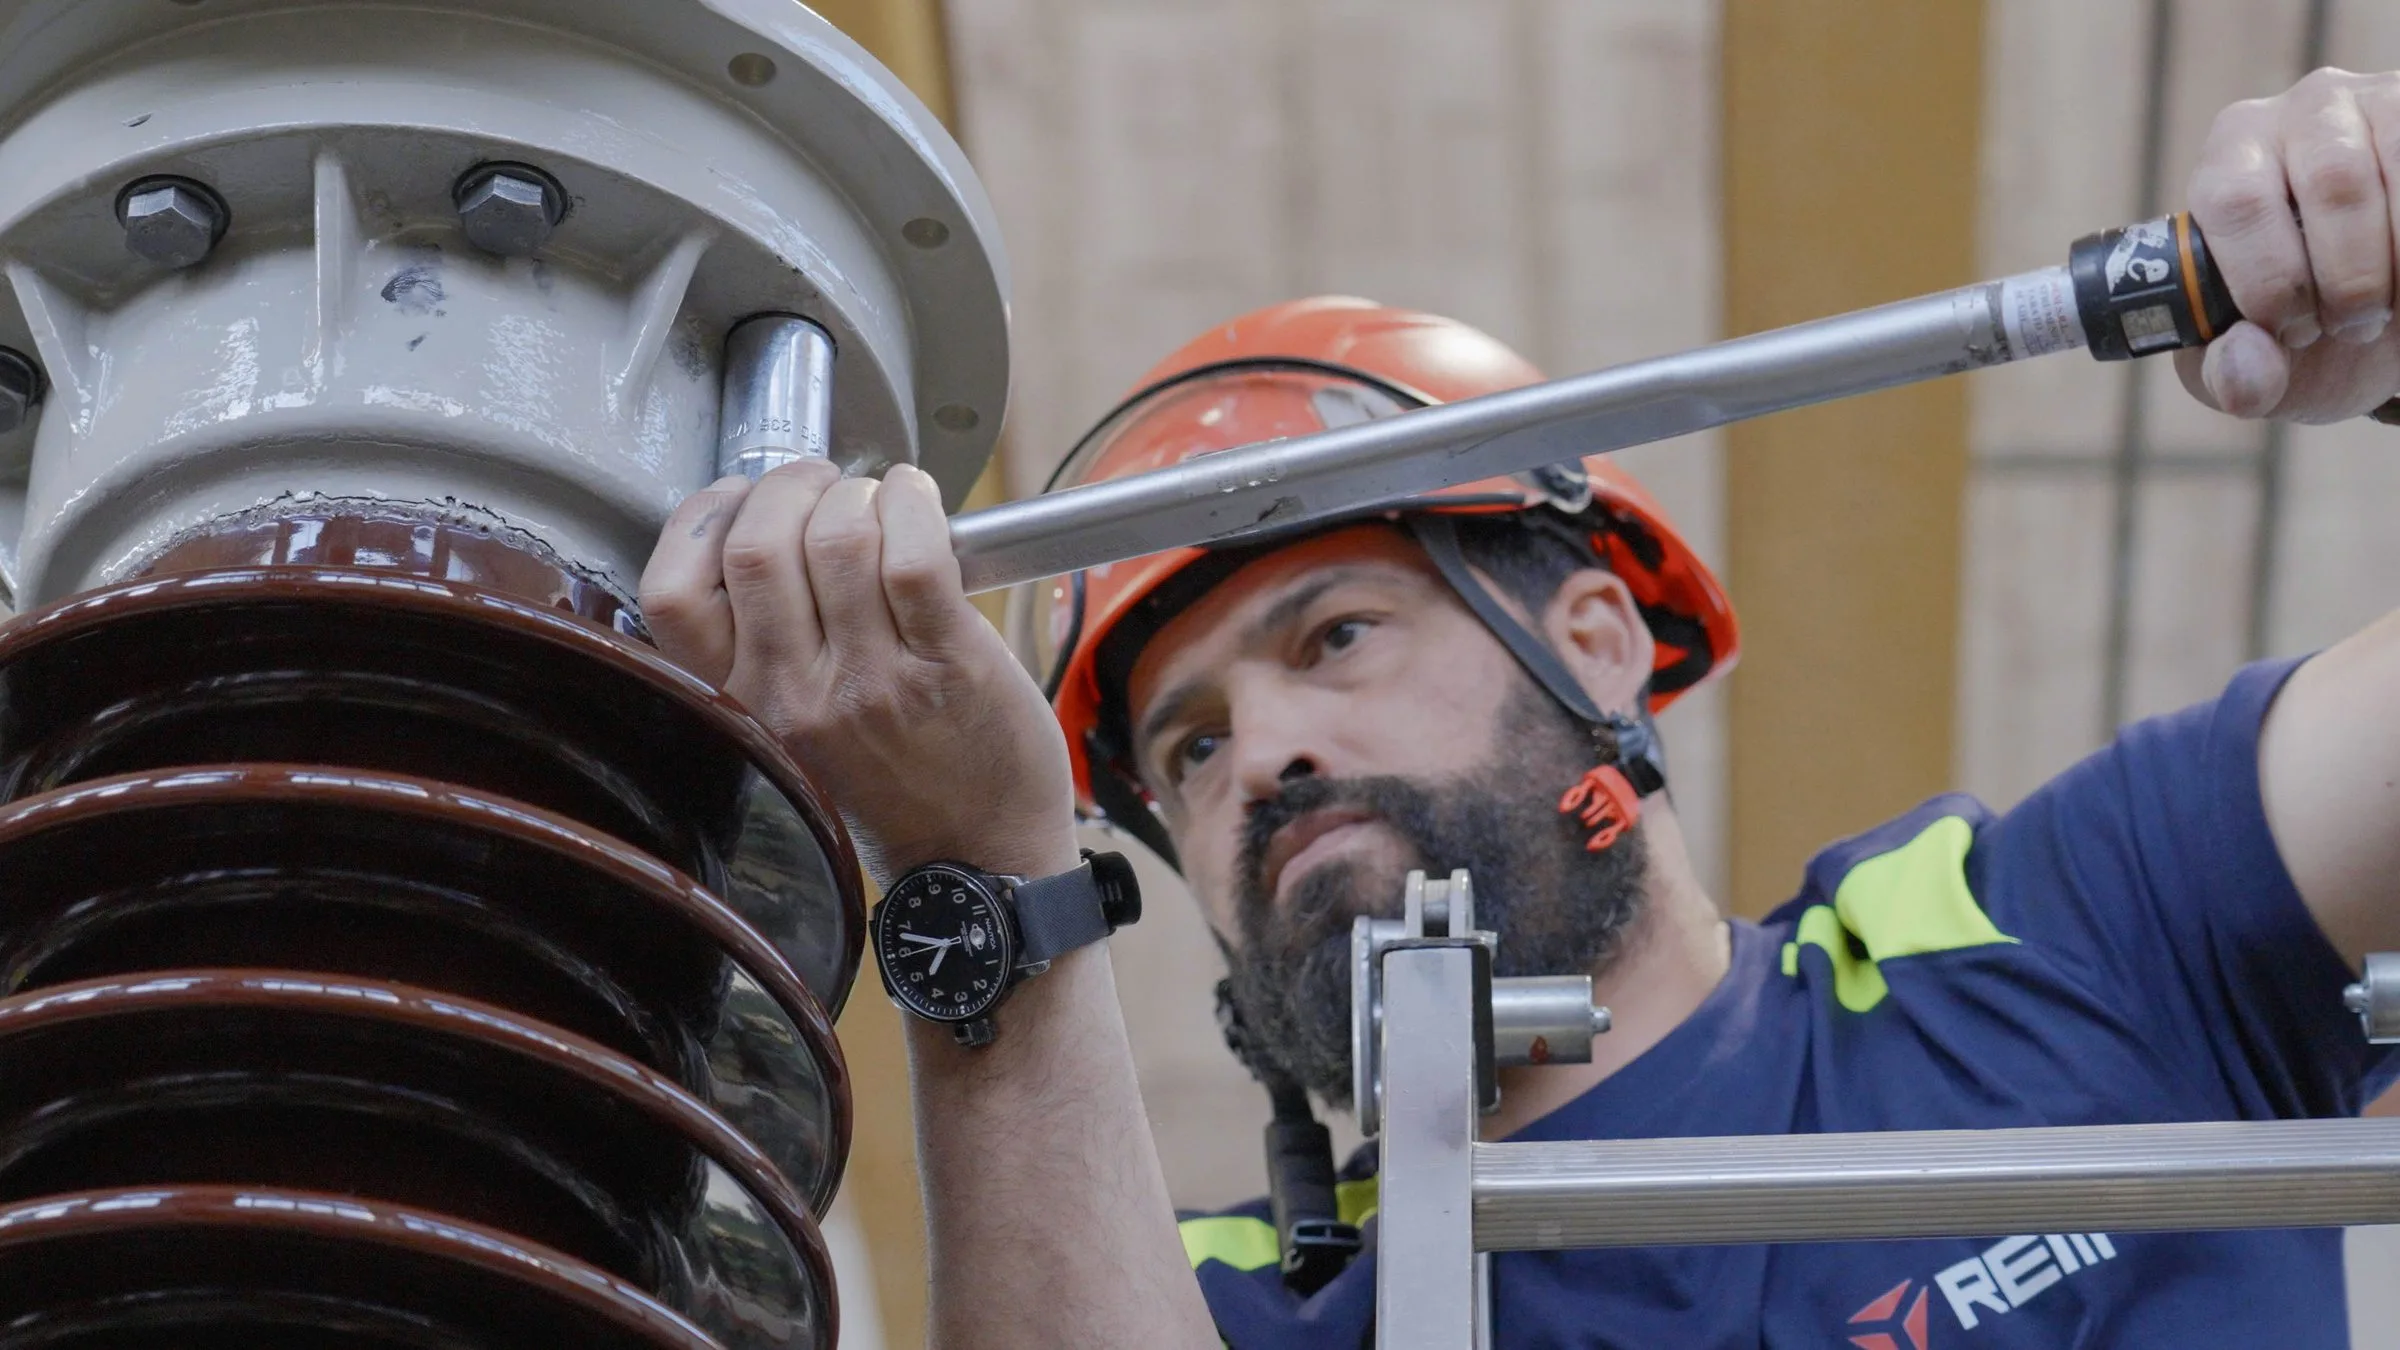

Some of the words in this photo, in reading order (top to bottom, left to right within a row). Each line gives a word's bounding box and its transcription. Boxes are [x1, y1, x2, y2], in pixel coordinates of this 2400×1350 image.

[928, 884, 941, 895] 9
[951, 887, 966, 904] 10
[908, 897, 921, 908] 8
[972, 904, 987, 915] 11
[899, 920, 912, 931] 7
[985, 917, 997, 950] NAUTICA
[910, 971, 924, 983] 5
[973, 979, 987, 991] 2
[931, 987, 945, 999] 4
[954, 991, 968, 1003] 3
